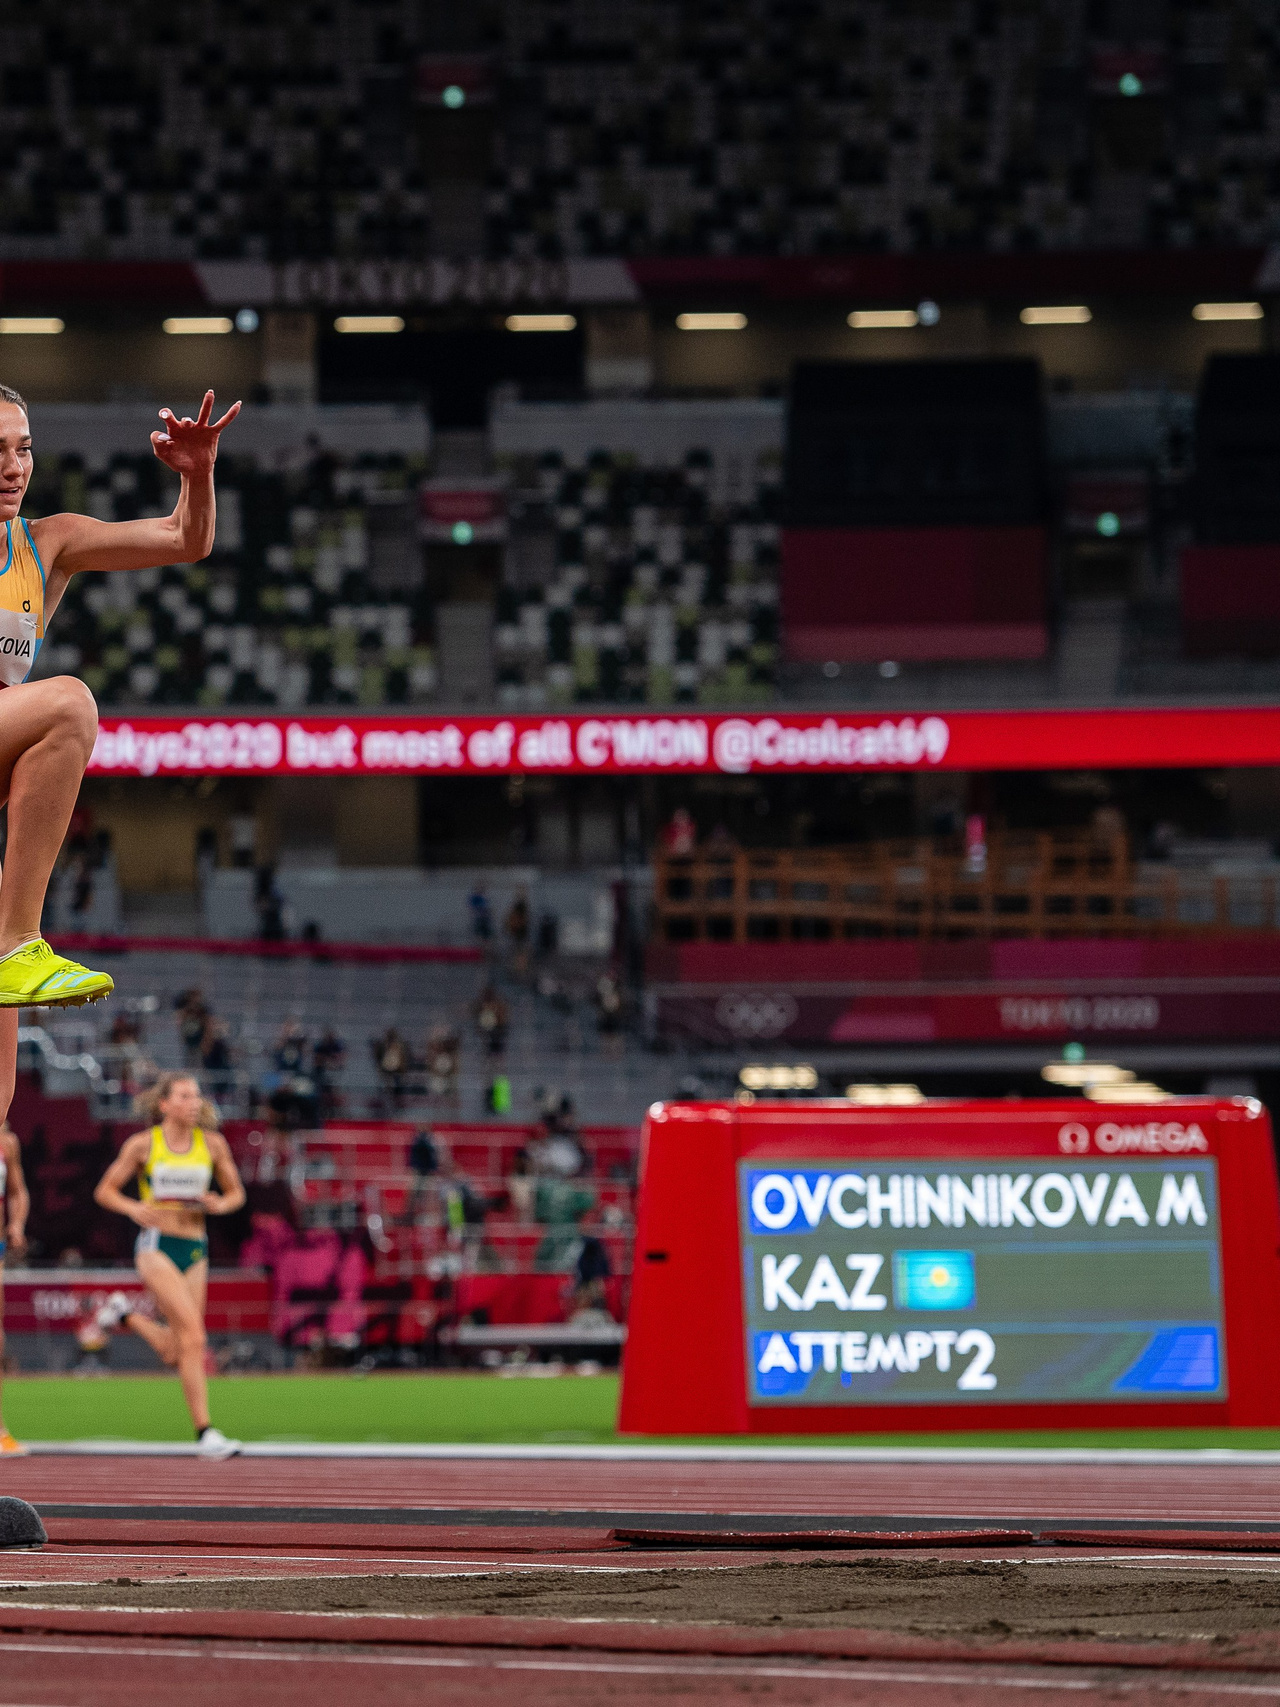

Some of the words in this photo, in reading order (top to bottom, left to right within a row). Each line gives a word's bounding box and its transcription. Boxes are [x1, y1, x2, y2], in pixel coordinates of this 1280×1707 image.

[286, 723, 356, 768] but
[362, 724, 462, 768] most
[468, 721, 514, 768] of
[518, 721, 572, 767] all
[577, 720, 708, 766] C'MON
[1094, 1121, 1209, 1154] OMEGA
[751, 1172, 1150, 1229] OVCHINNIKOVA
[1155, 1173, 1208, 1227] M
[761, 1253, 888, 1311] KAZ
[757, 1330, 958, 1373] ATTEMPT
[955, 1329, 997, 1391] 2
